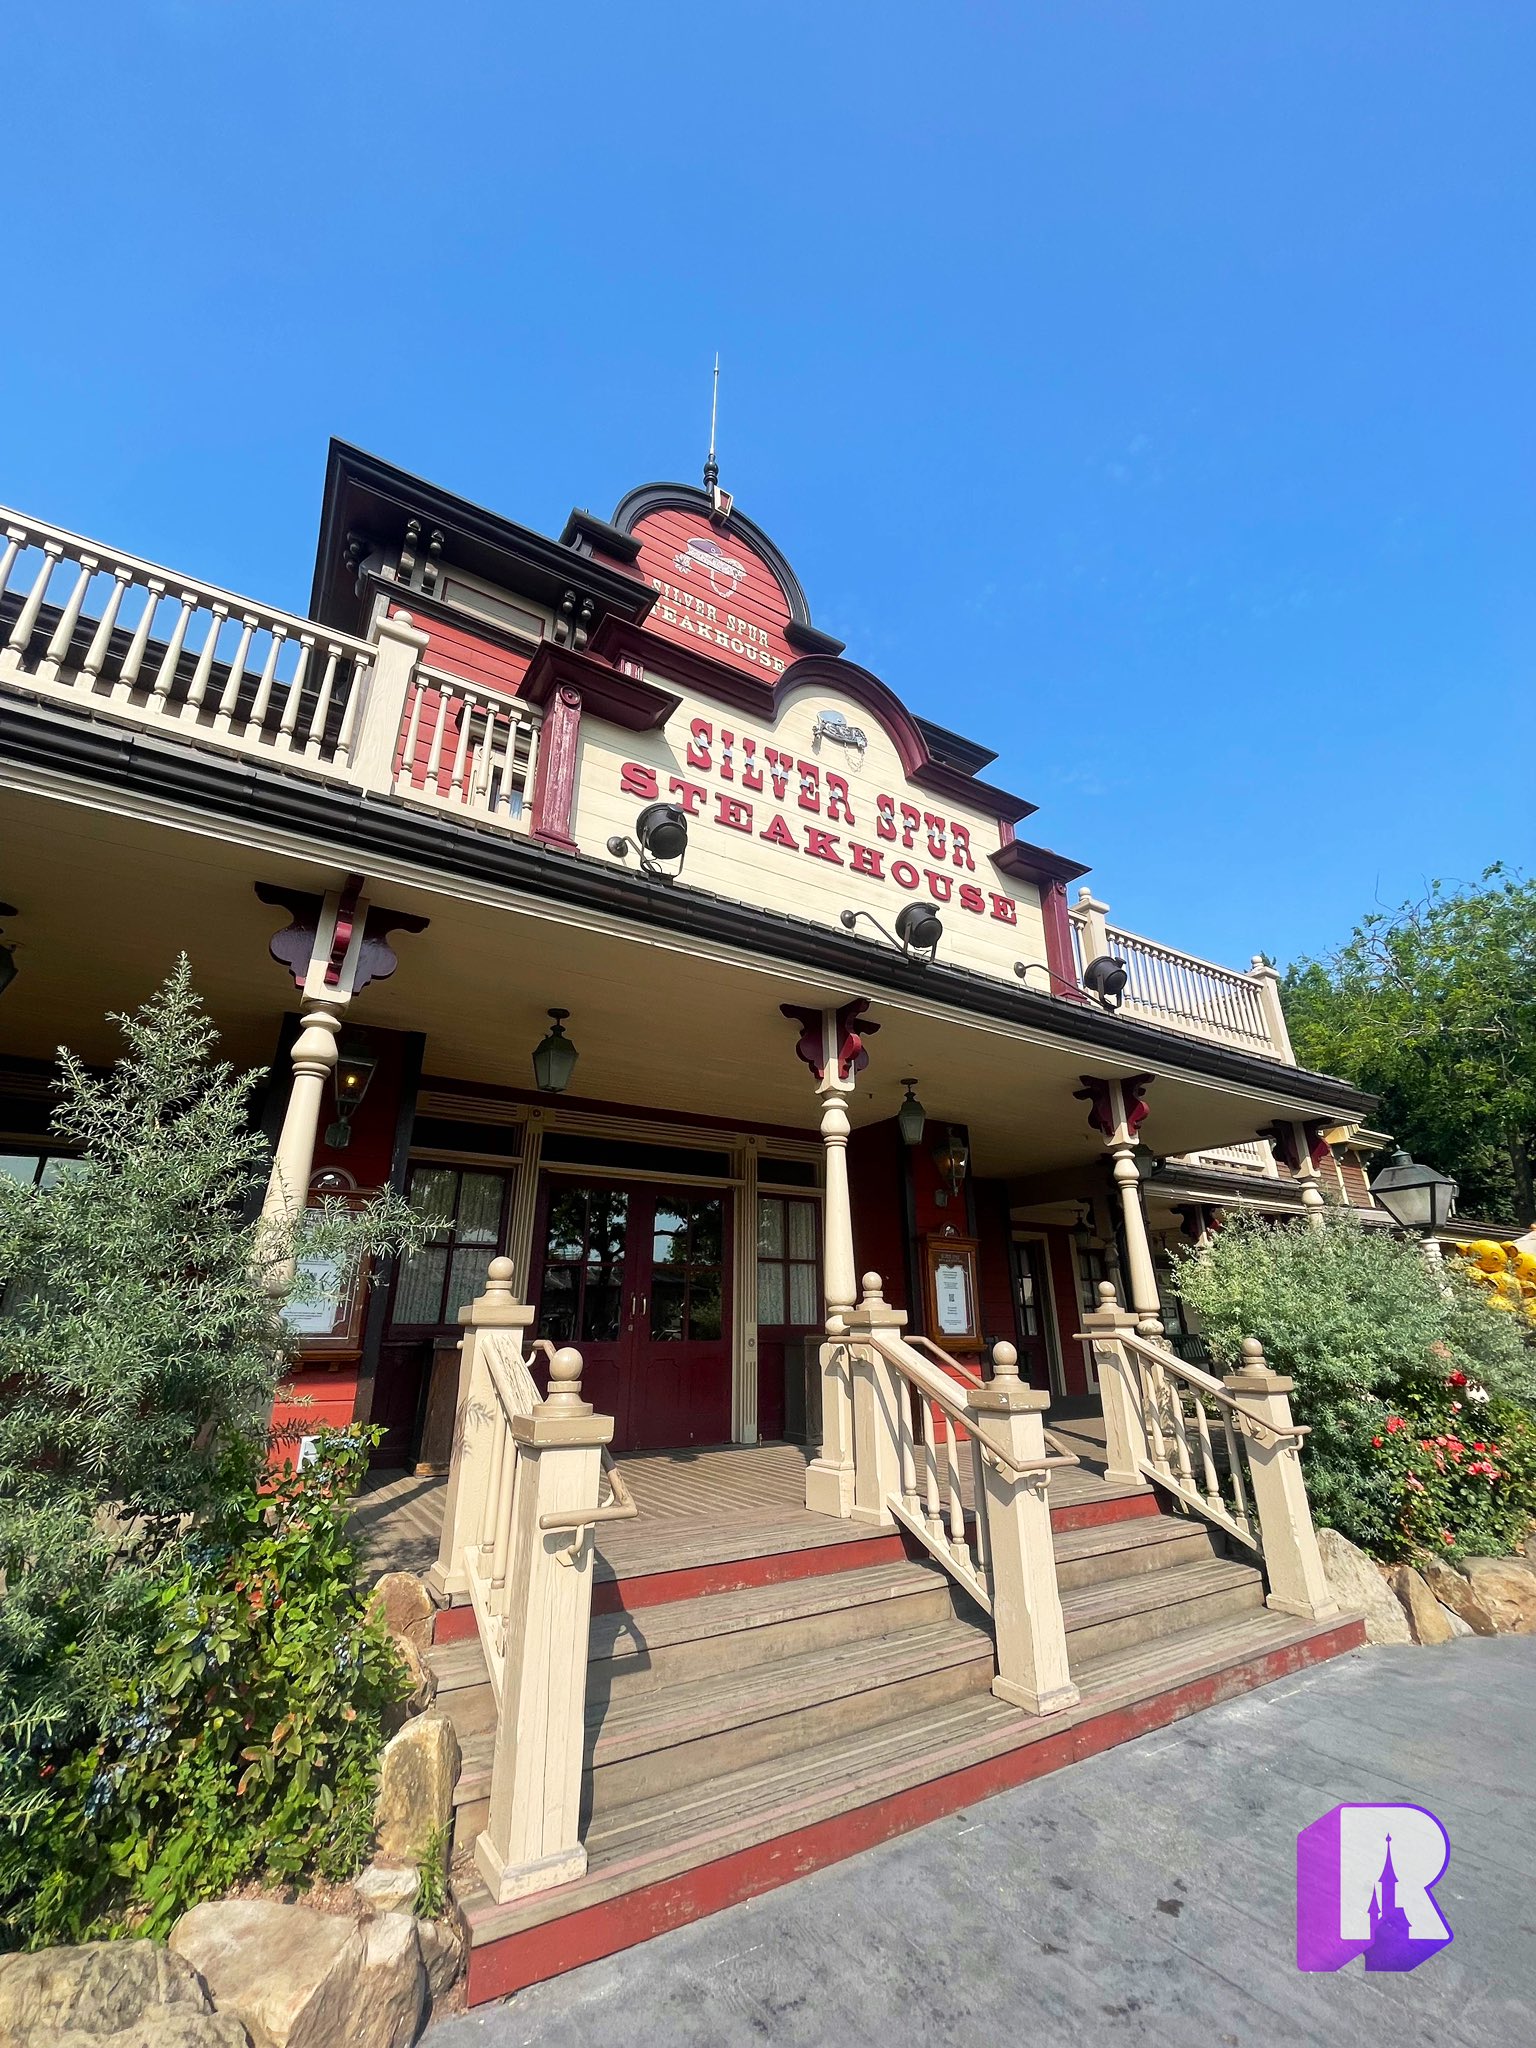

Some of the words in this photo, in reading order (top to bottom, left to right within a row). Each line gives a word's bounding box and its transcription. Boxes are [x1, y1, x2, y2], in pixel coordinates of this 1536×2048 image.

[649, 601, 785, 673] TEAKHOUSE
[652, 578, 717, 623] SILVER
[726, 614, 769, 648] SPUR
[620, 762, 1018, 924] STEAKHOUSE
[687, 717, 855, 825] SILVER
[876, 793, 976, 870] SPUR
